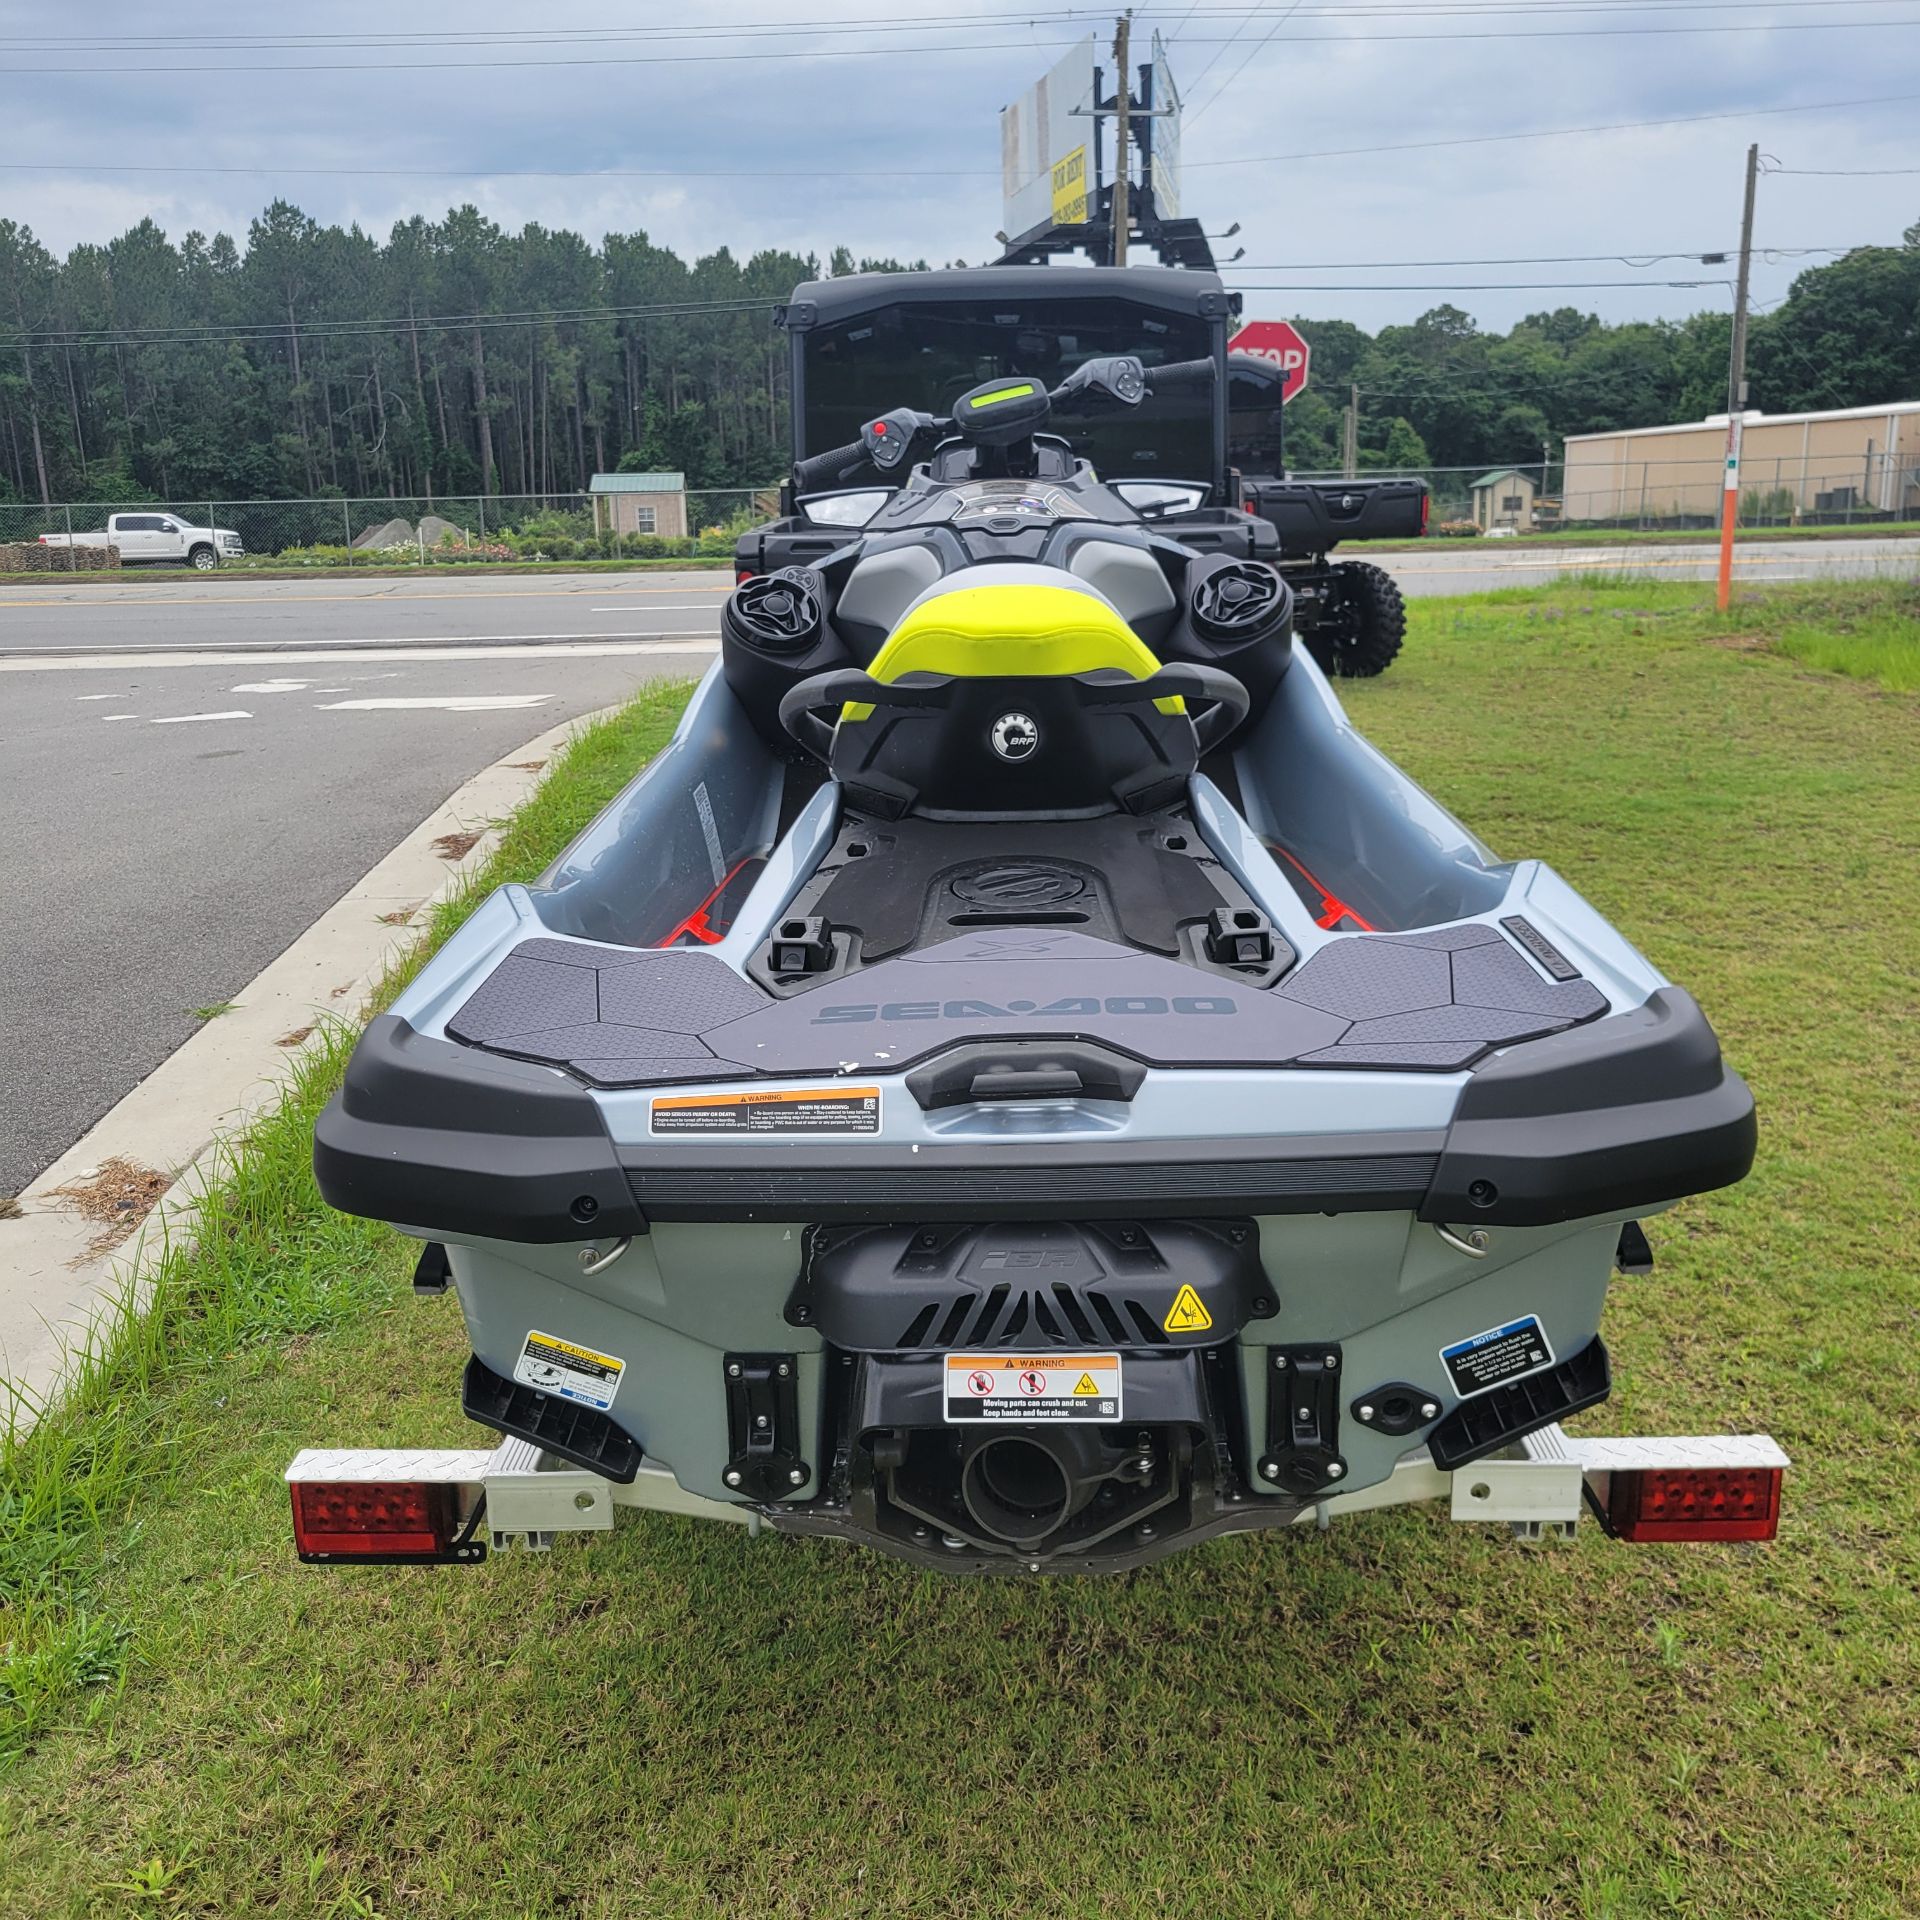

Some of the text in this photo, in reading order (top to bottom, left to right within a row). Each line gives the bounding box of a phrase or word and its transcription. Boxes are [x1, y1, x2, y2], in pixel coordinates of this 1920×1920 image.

[1010, 737, 1035, 745] BRP
[747, 1094, 782, 1102] WARNING
[1472, 1330, 1504, 1347] NOTICE
[564, 1345, 600, 1361] CAUTION
[1019, 1360, 1065, 1368] WARNING
[572, 1392, 598, 1405] NOTICE
[983, 1399, 1008, 1408] Moving
[1009, 1400, 1027, 1408] parts
[1041, 1399, 1060, 1407] crush
[1061, 1399, 1074, 1407] and
[983, 1409, 1070, 1418] Keep hands and feet clear.
